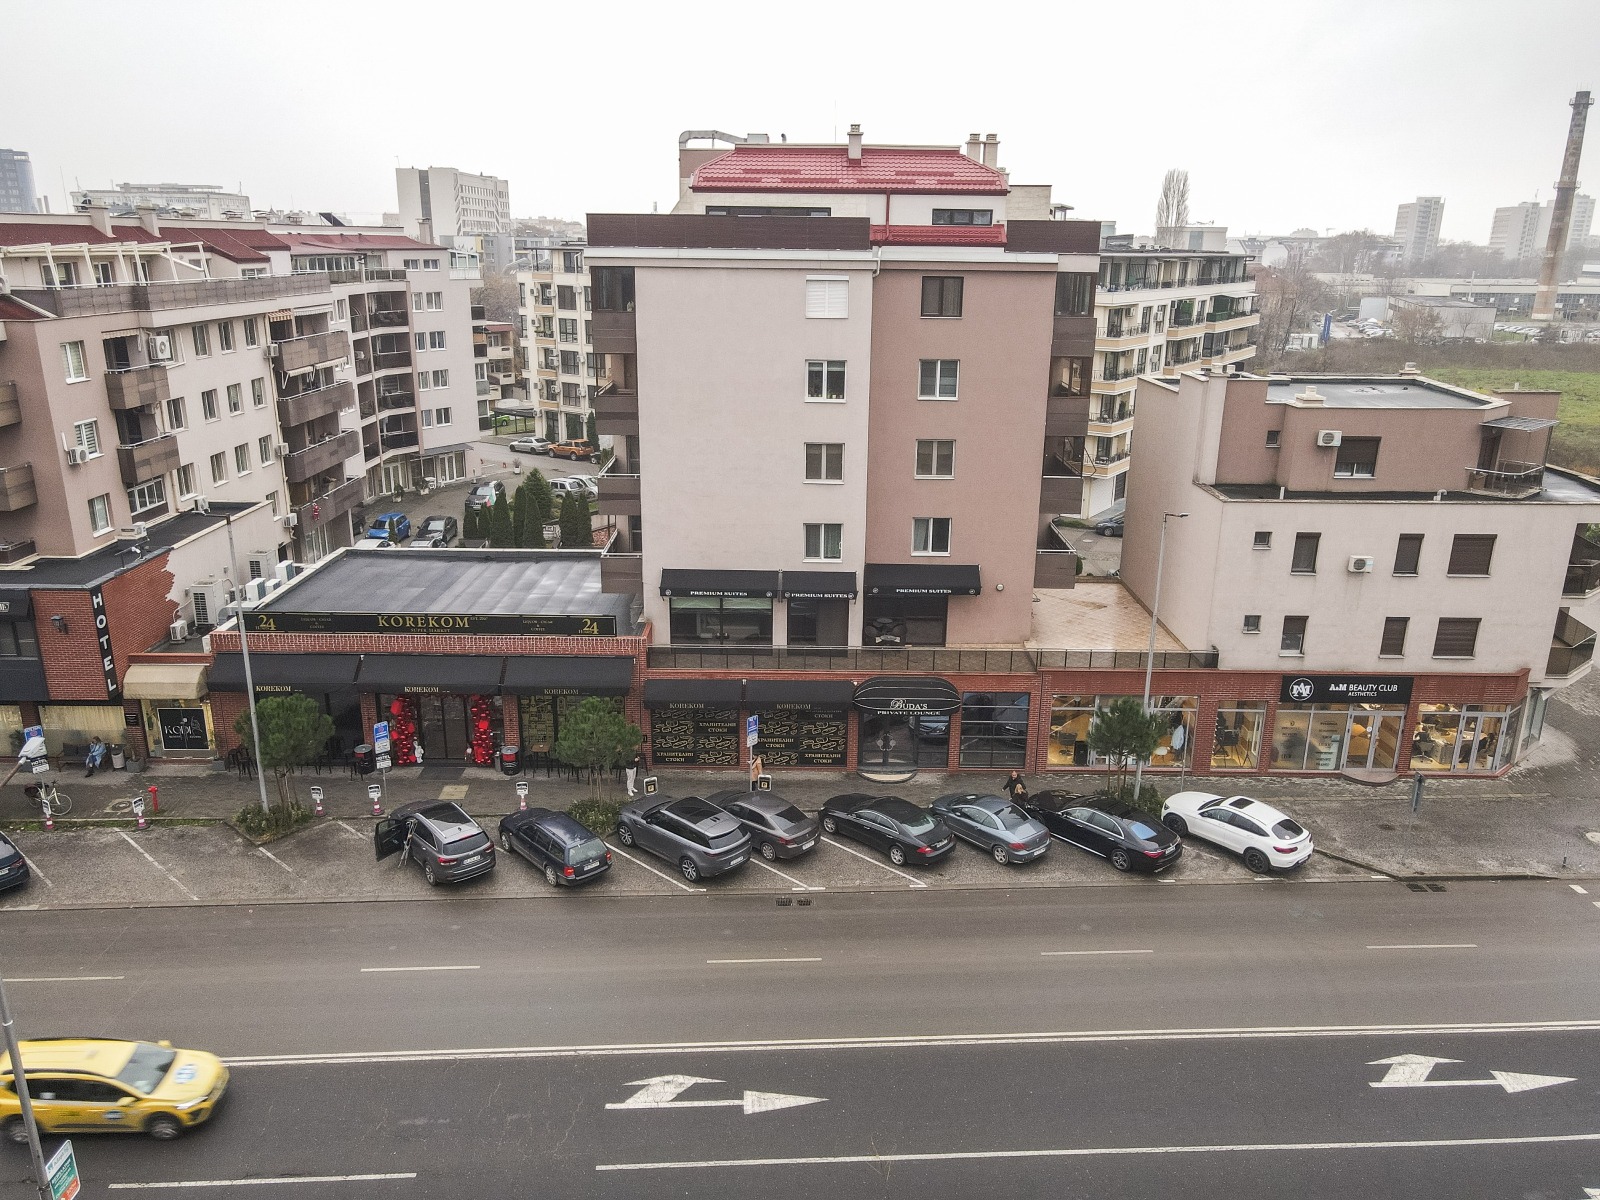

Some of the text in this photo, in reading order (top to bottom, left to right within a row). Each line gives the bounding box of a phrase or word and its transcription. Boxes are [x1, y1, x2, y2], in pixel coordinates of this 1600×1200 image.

[258, 615, 277, 631] 24
[377, 615, 470, 628] KOREKOM
[582, 618, 599, 634] 24
[92, 592, 117, 692] HOTEL
[1348, 684, 1378, 692] BEAUTY
[1378, 684, 1398, 692] CLUB
[890, 699, 928, 709] BUDA'S
